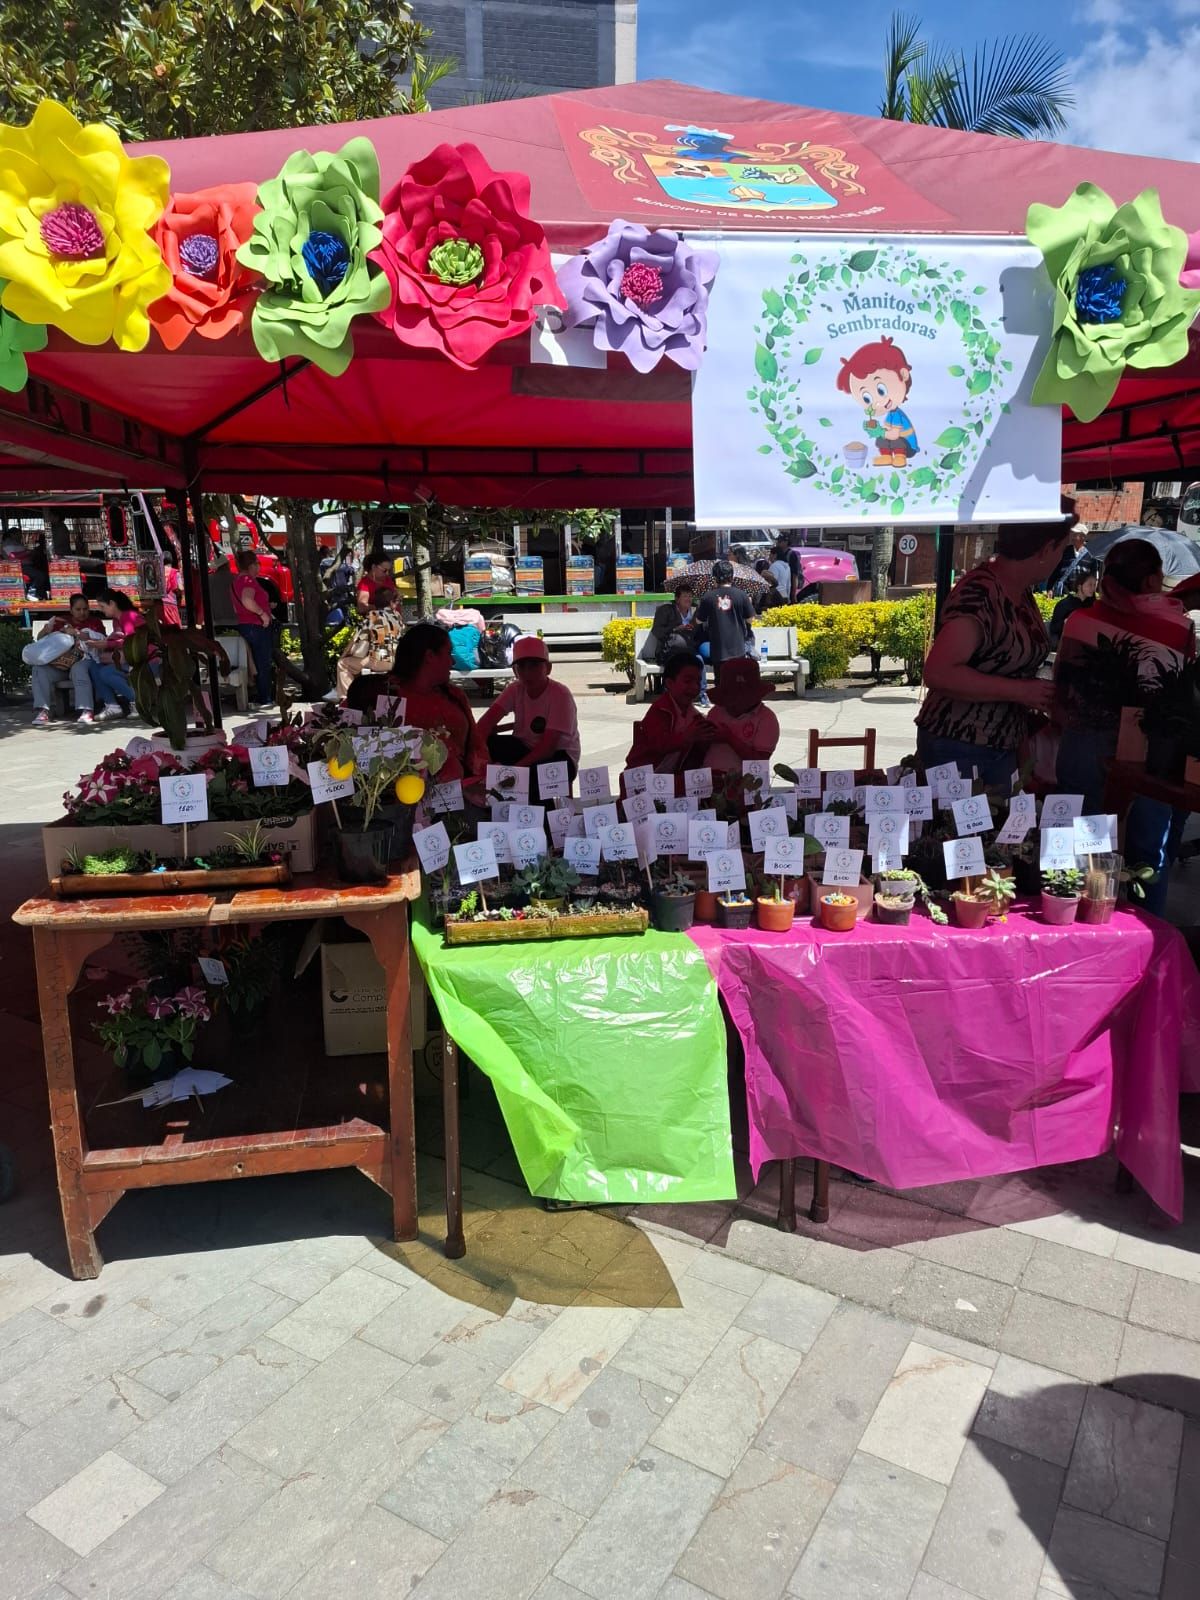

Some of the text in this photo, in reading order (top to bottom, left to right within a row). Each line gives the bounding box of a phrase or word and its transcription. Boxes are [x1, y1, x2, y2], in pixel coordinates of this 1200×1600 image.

[633, 198, 712, 214] MUNICIPIO
[743, 213, 797, 221] SANTA
[842, 291, 915, 315] Manitos
[827, 314, 937, 340] Sembradoras
[901, 538, 916, 551] 30
